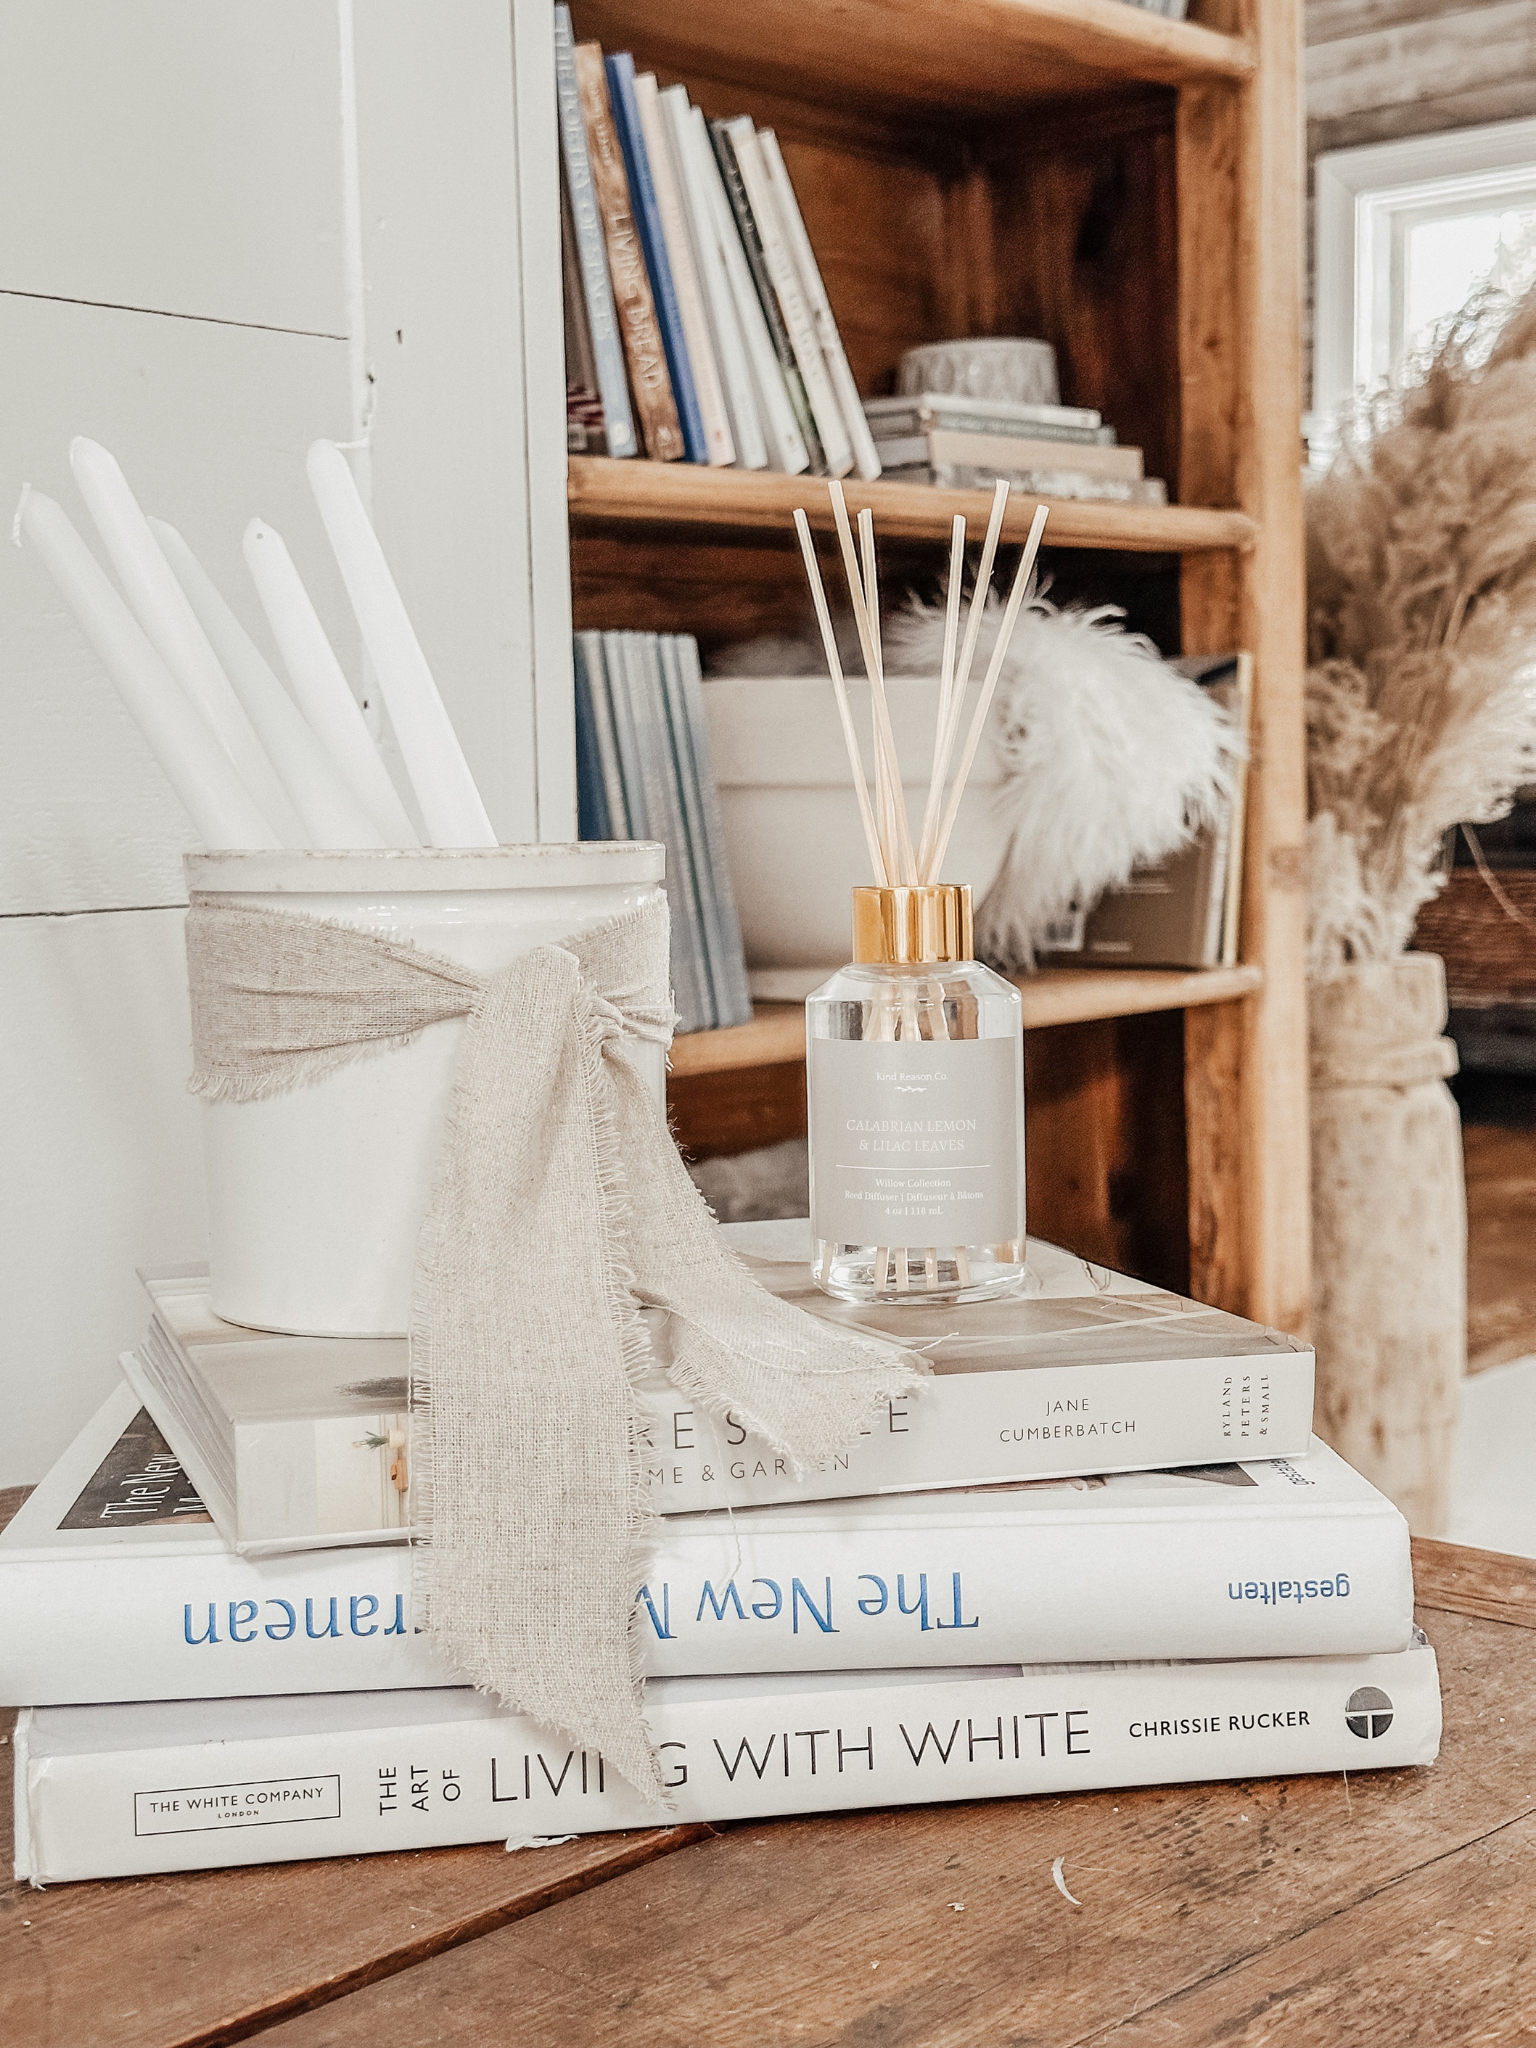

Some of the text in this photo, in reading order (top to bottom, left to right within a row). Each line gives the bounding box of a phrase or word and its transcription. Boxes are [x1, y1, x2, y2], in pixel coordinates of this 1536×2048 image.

[609, 214, 664, 390] LIVING BREAD
[876, 1072, 897, 1081] Kind
[899, 1072, 932, 1081] Reason
[846, 1119, 976, 1132] CALABRIAN LEMON
[859, 1139, 965, 1152] & LILAC LEAVES
[844, 1190, 863, 1200] Reed
[864, 1191, 899, 1201] Diffuser
[875, 1177, 952, 1188] Willow Collection
[884, 1205, 943, 1216] 4 oz 118 mL
[1045, 1398, 1090, 1416] JANE
[1222, 1376, 1233, 1437] RYLAND
[1241, 1375, 1251, 1437] PETERS
[999, 1420, 1136, 1443] CUMBERBATCH
[100, 1452, 182, 1518] The New
[701, 1464, 715, 1482] &
[857, 1571, 980, 1632] The
[1228, 1572, 1350, 1605] gestalten
[695, 1575, 841, 1634] New
[1129, 1710, 1311, 1738] CHRISSIE RUCKER
[712, 1726, 874, 1782] WITH
[898, 1710, 1091, 1767] WHITE
[378, 1766, 397, 1816] THE
[411, 1764, 429, 1812] ART
[442, 1768, 461, 1802] OF
[150, 1787, 324, 1814] THE WHITE COMPANY
[218, 1809, 260, 1819] LONDON
